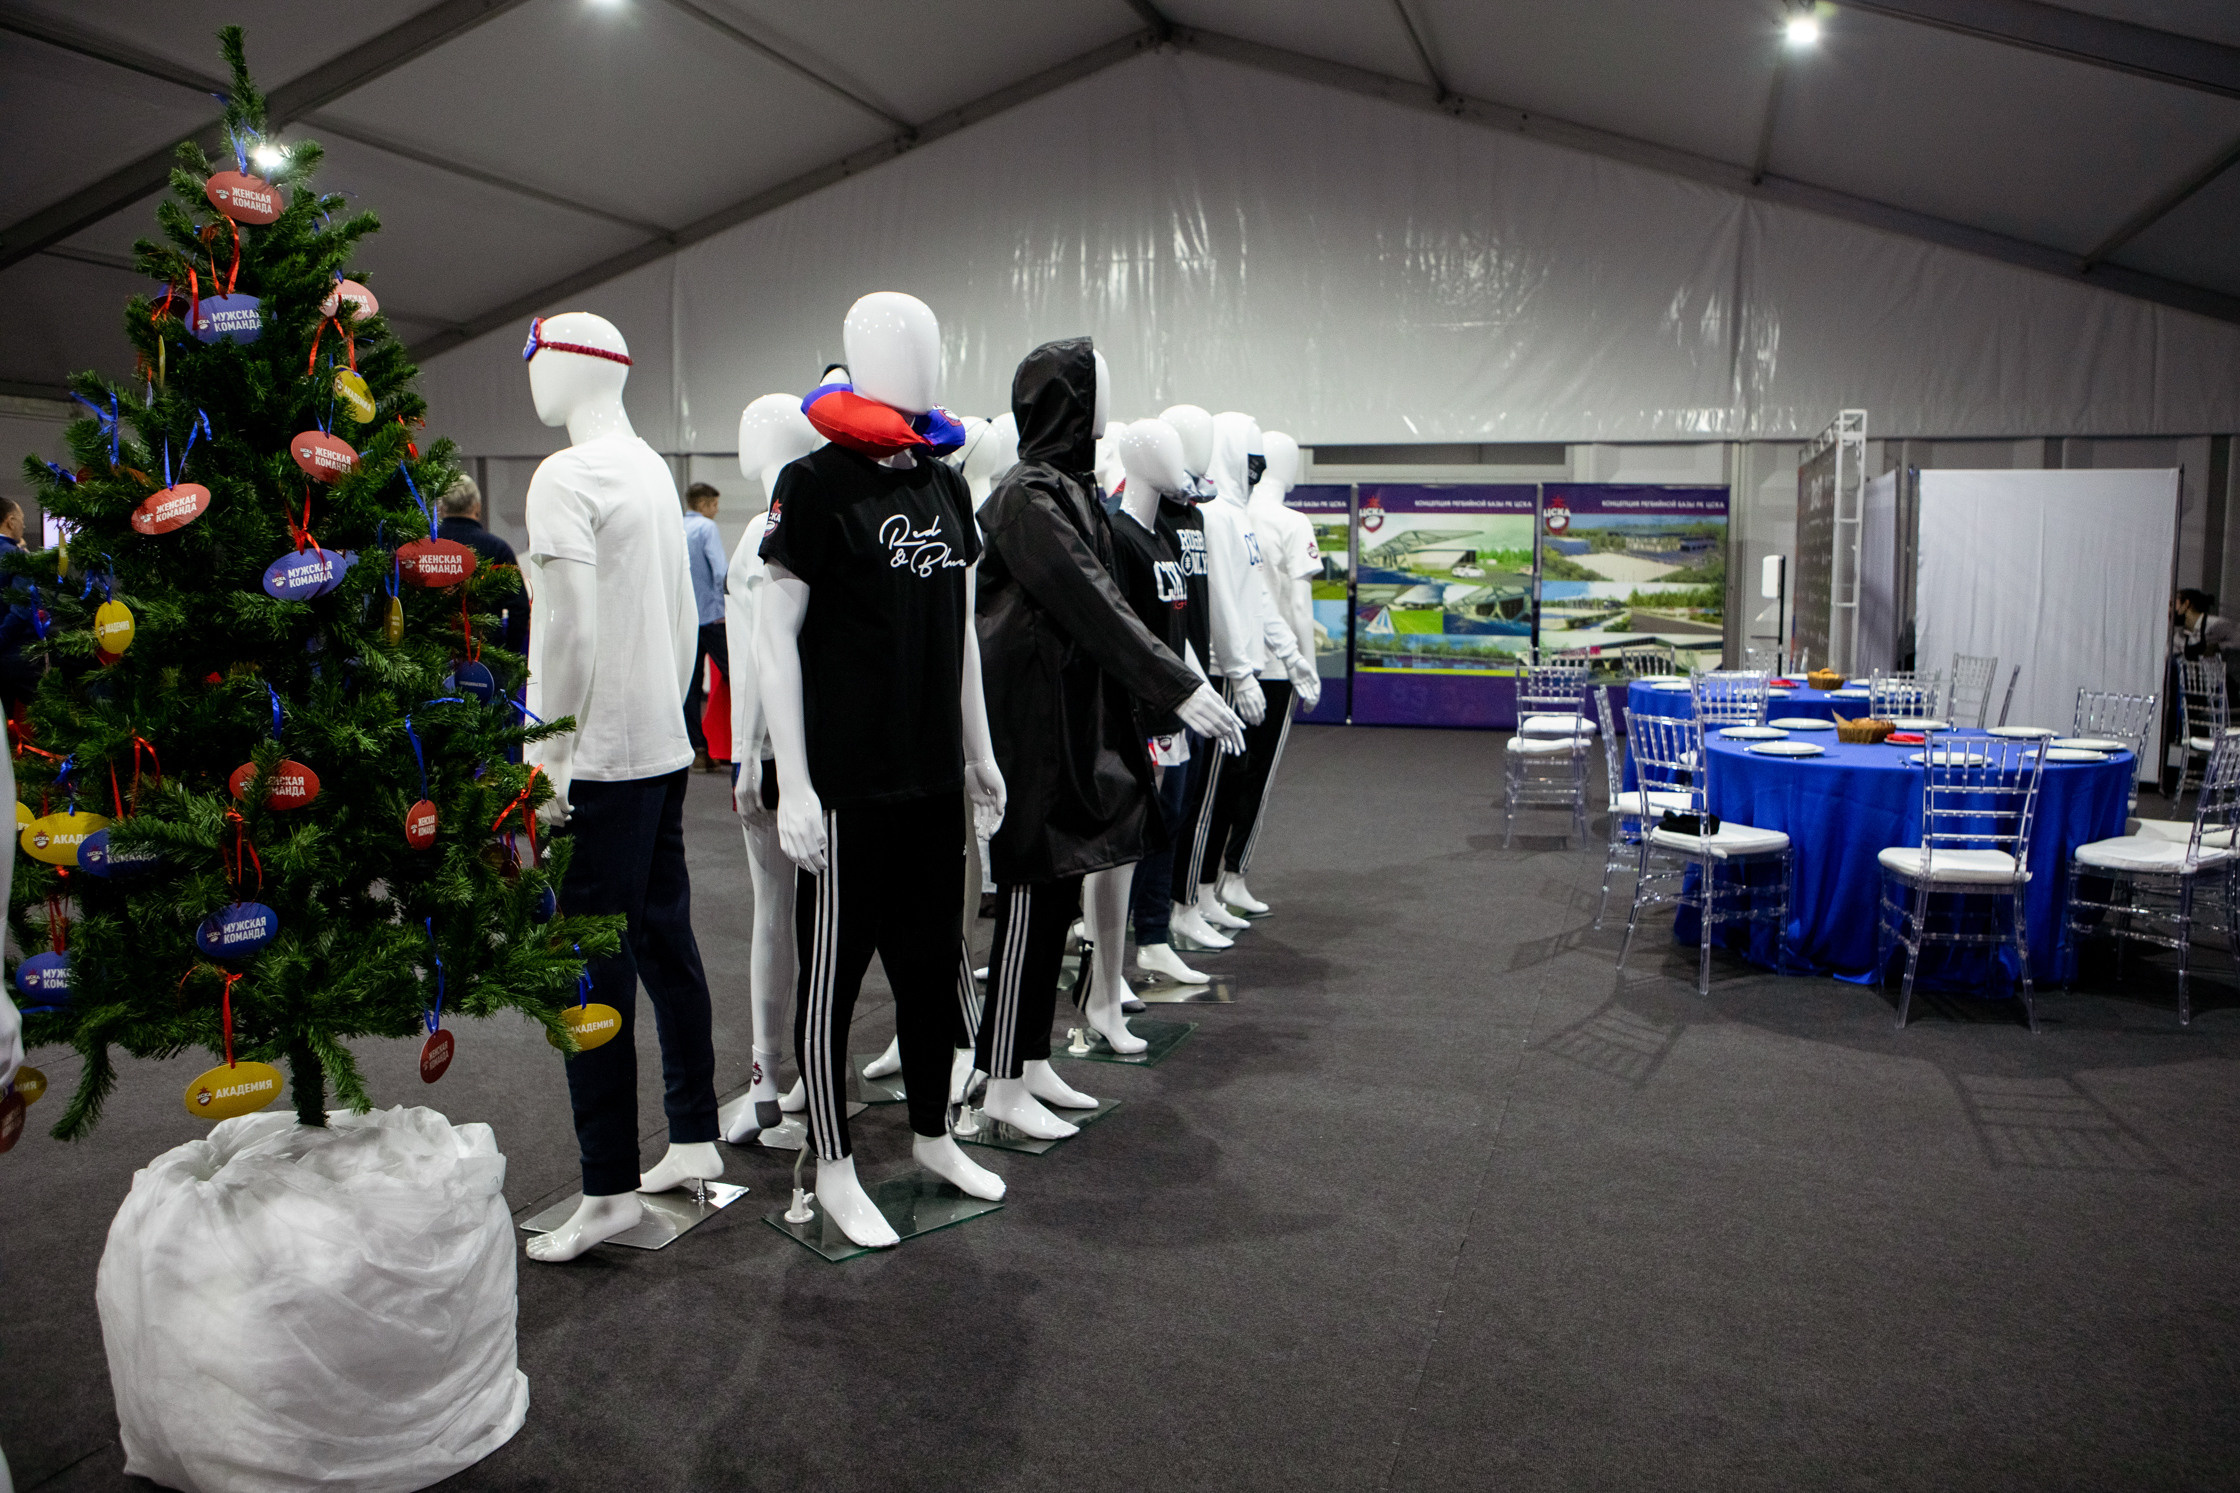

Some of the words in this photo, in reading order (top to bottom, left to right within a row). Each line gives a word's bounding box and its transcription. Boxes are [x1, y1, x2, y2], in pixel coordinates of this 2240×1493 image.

[232, 187, 271, 204] ЖЕНСКАЯ
[233, 197, 273, 214] КОМАНДА
[315, 446, 351, 464] ЖЕНСКАЯ
[156, 494, 197, 514] ЖЕНСКАЯ
[156, 503, 197, 523] КОМАНДА
[1359, 508, 1386, 518] ЦСКА
[1543, 507, 1571, 518] ЦСКА
[879, 514, 941, 550] Red
[1176, 529, 1206, 551] RUGB
[418, 554, 462, 564] ЖЕНСКАЯ
[890, 548, 908, 568] &
[910, 542, 967, 578] Blue
[288, 560, 333, 579] МУЖСКАЯ
[419, 564, 463, 574] КОМАНДА
[289, 571, 333, 588] КОМАНДА
[223, 916, 267, 934] МУЖСКАЯ
[223, 926, 267, 944] КОМАНДА
[215, 1079, 273, 1099] АКАДЕМИЯ
